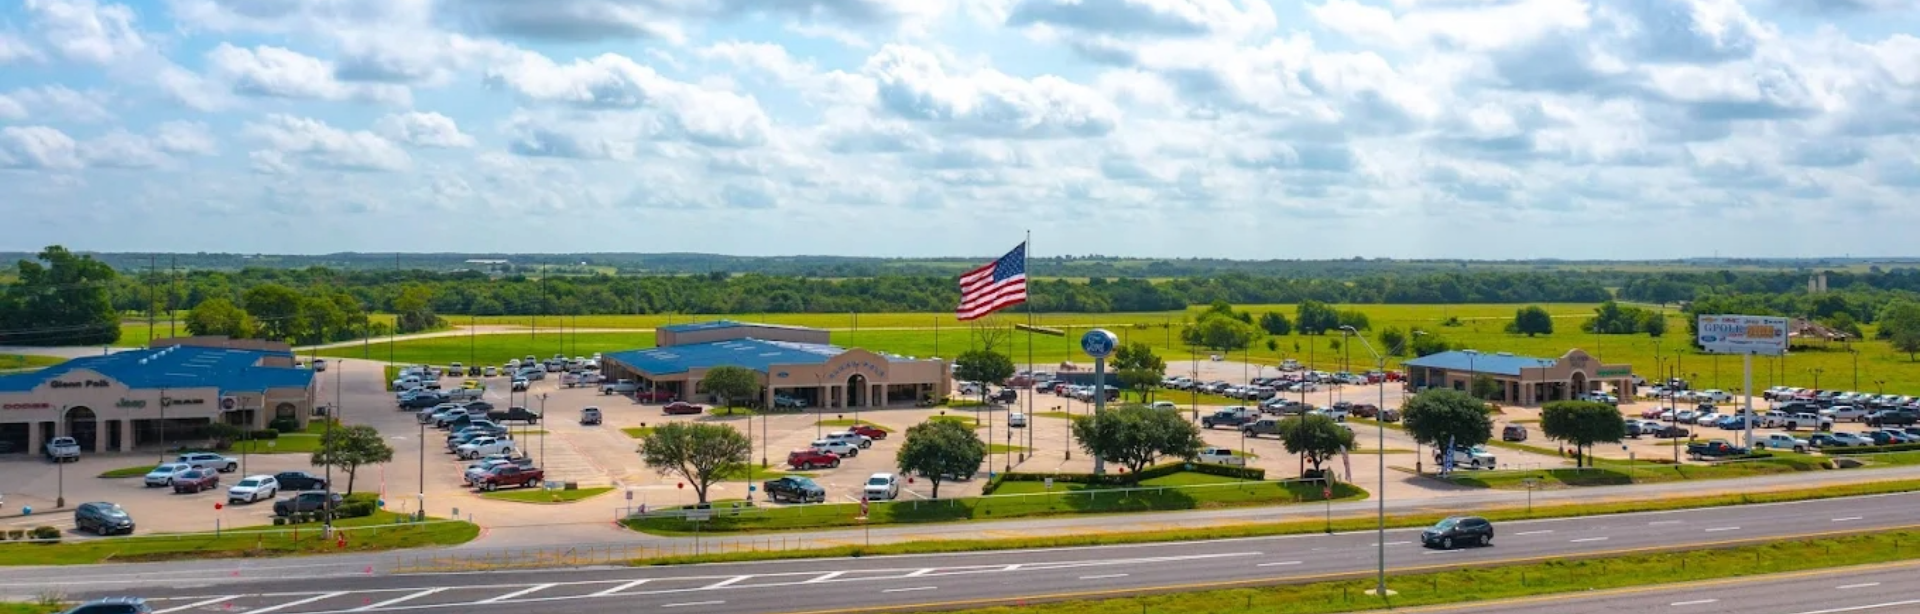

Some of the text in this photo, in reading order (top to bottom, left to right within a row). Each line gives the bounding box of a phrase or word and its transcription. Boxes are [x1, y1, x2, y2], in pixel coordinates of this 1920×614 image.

[1086, 335, 1106, 353] Ford
[50, 379, 110, 388] Glenn Polk
[115, 397, 146, 409] Jeep
